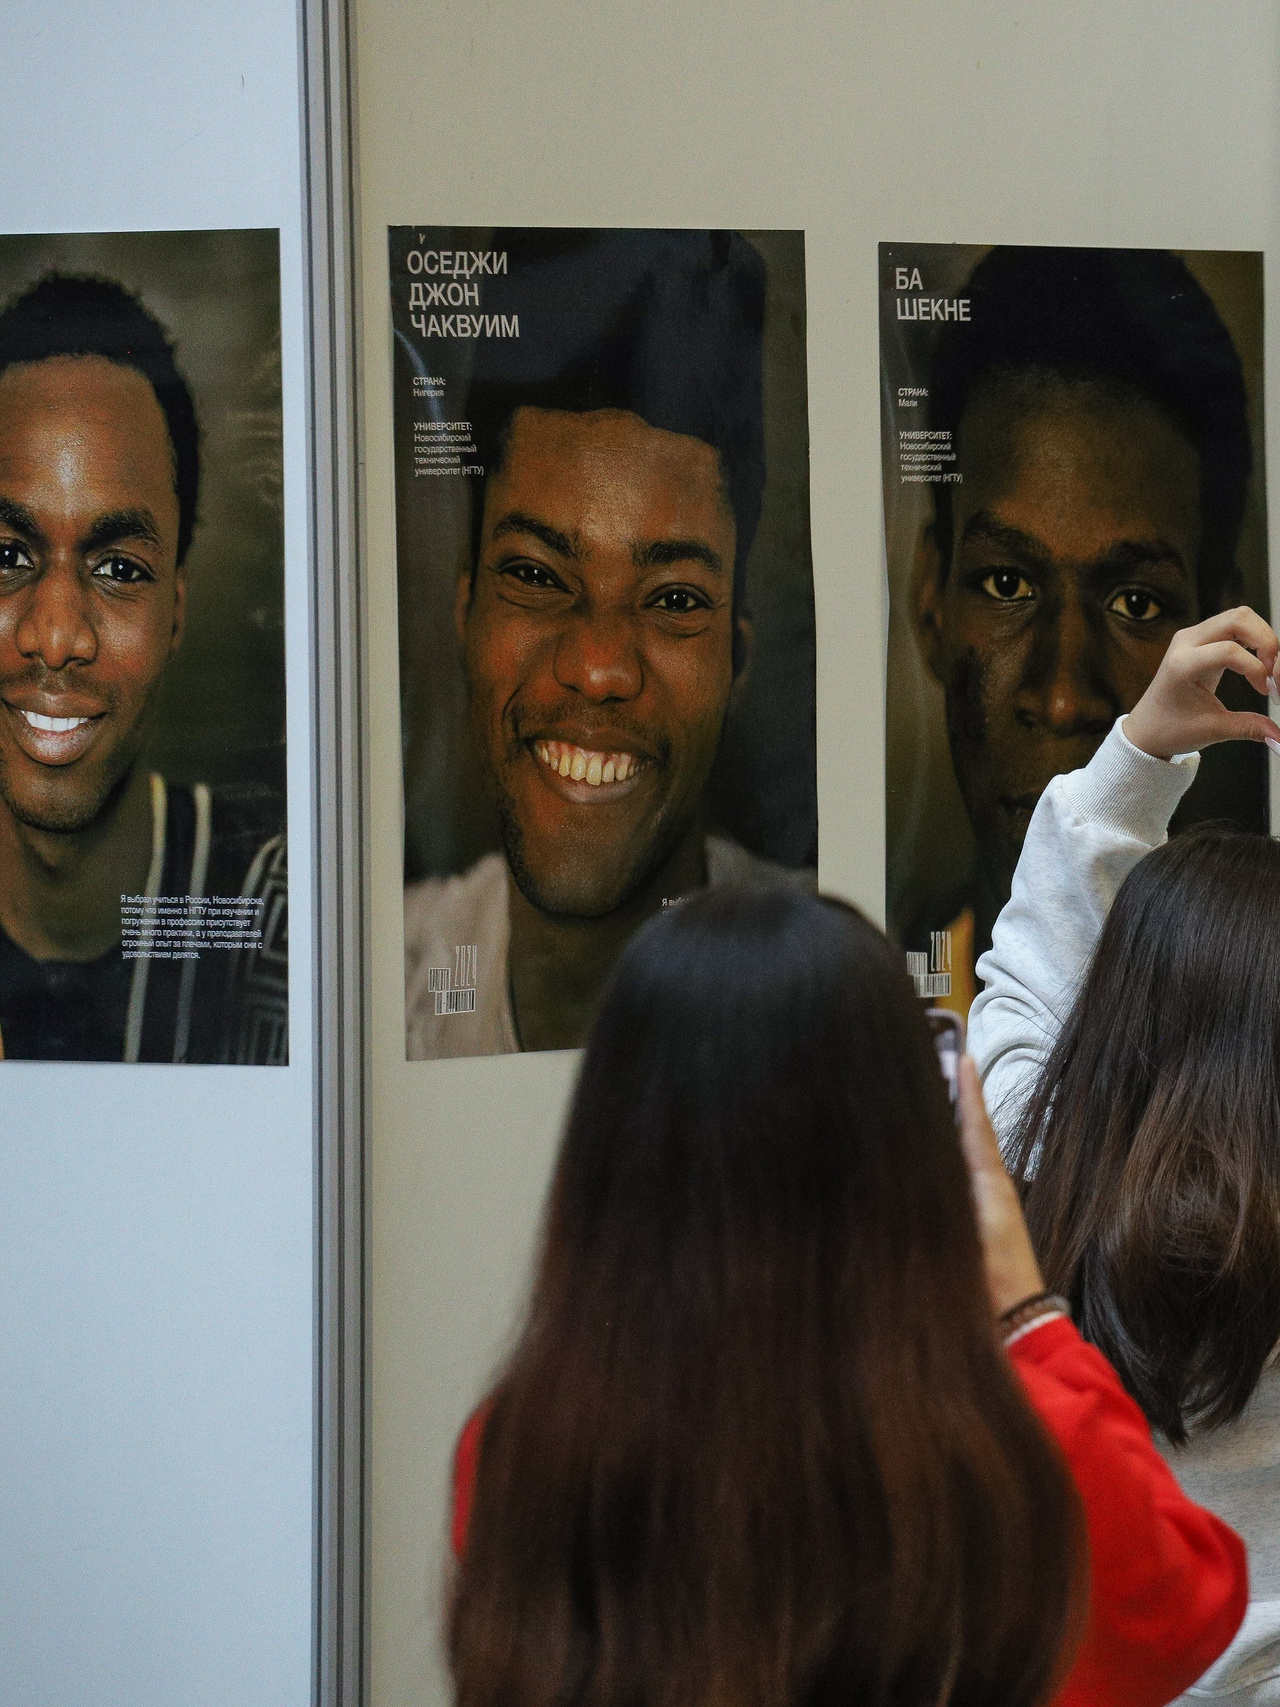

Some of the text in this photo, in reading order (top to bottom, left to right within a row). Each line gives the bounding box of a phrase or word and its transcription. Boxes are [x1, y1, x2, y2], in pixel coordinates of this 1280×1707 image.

[407, 251, 507, 279] ОСЕДЖИ
[896, 268, 922, 290] БА
[409, 283, 479, 310] ДЖОН
[897, 299, 971, 321] ШЕКНЕ
[411, 315, 519, 337] ЧАКВУИМ
[413, 377, 446, 386] СТРАНА:
[414, 388, 444, 398] Нигерия
[898, 388, 928, 396] СТРАНА:
[899, 399, 917, 407] Мали
[414, 422, 472, 431] УНИВЕРСИТЕТ:
[415, 433, 471, 443] Новосибирский
[900, 431, 952, 440] УНИВЕРСИТЕТ:
[415, 444, 476, 454] государственный
[900, 442, 951, 451] Новосибирский
[901, 453, 956, 461] государственный
[415, 466, 484, 476] университет (НГТУ)
[943, 474, 963, 483] (НГТУ)
[120, 895, 126, 903] Я
[127, 895, 151, 904] выбрал
[186, 895, 211, 905] России,
[213, 896, 264, 905] Новосибирске,
[662, 898, 667, 906] Я
[189, 906, 206, 914] НГТУ
[207, 929, 261, 938] преподавателей
[122, 938, 154, 948] огромный
